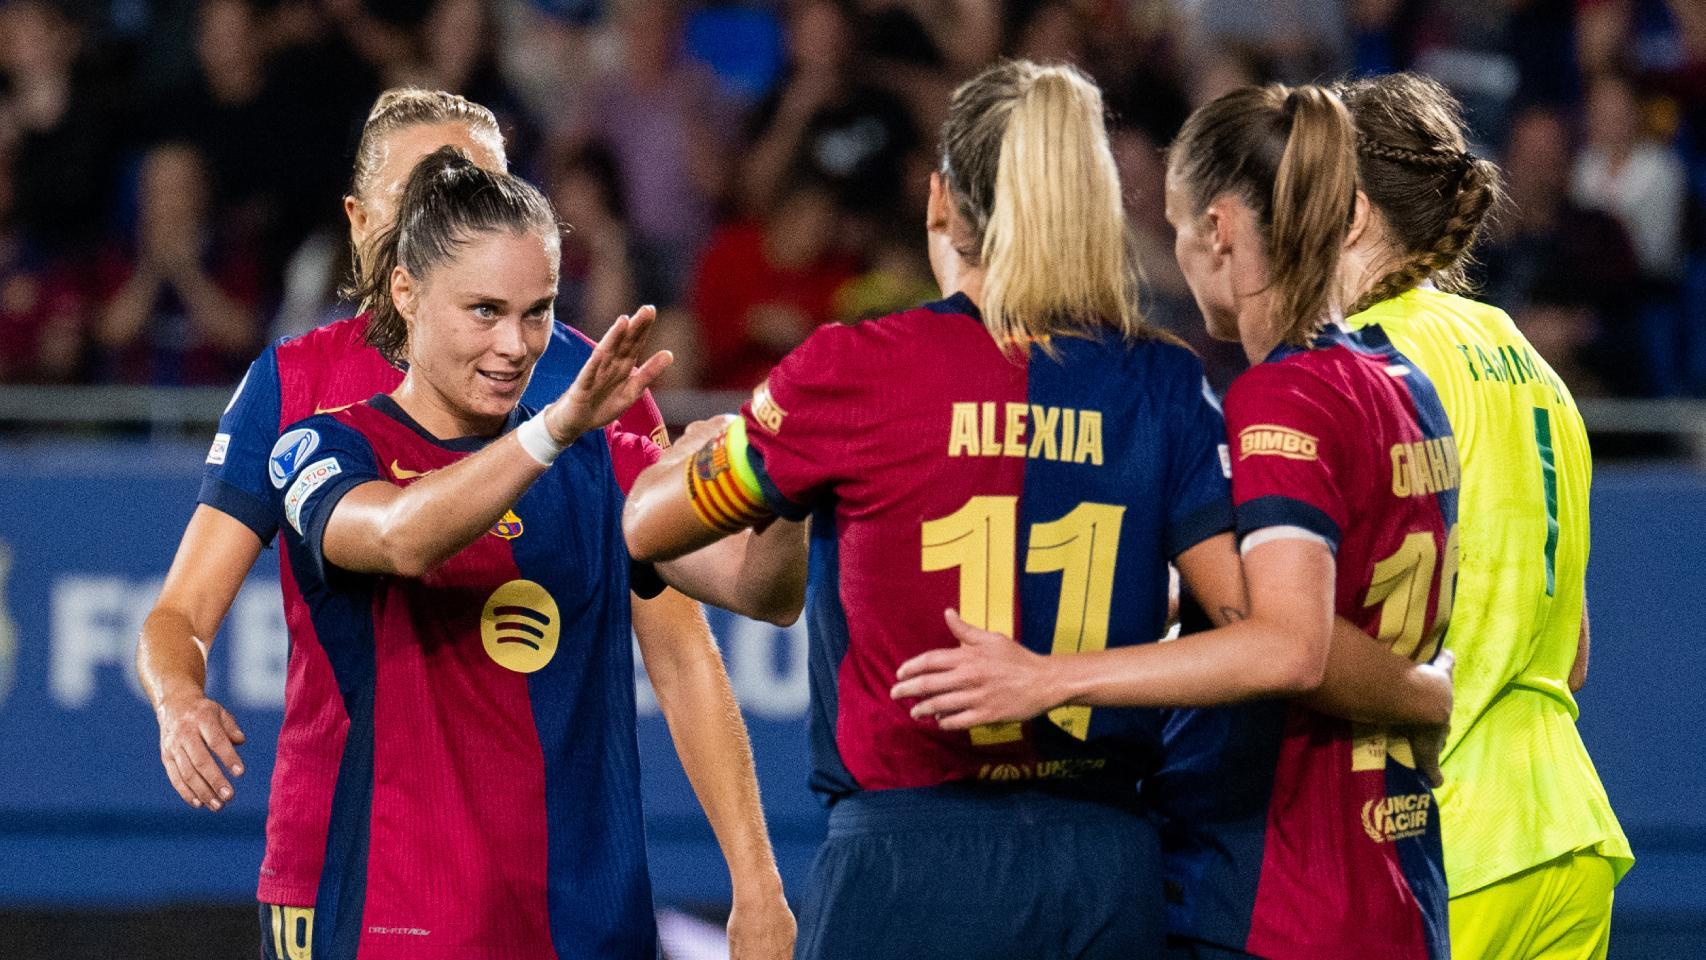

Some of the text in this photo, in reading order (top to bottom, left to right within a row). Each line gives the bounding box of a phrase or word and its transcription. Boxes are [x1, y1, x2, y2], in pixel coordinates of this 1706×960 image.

[948, 401, 1104, 466] ALEXIA
[1240, 430, 1318, 457] BIMBO
[1532, 406, 1559, 598] 1
[921, 495, 1127, 746] 11
